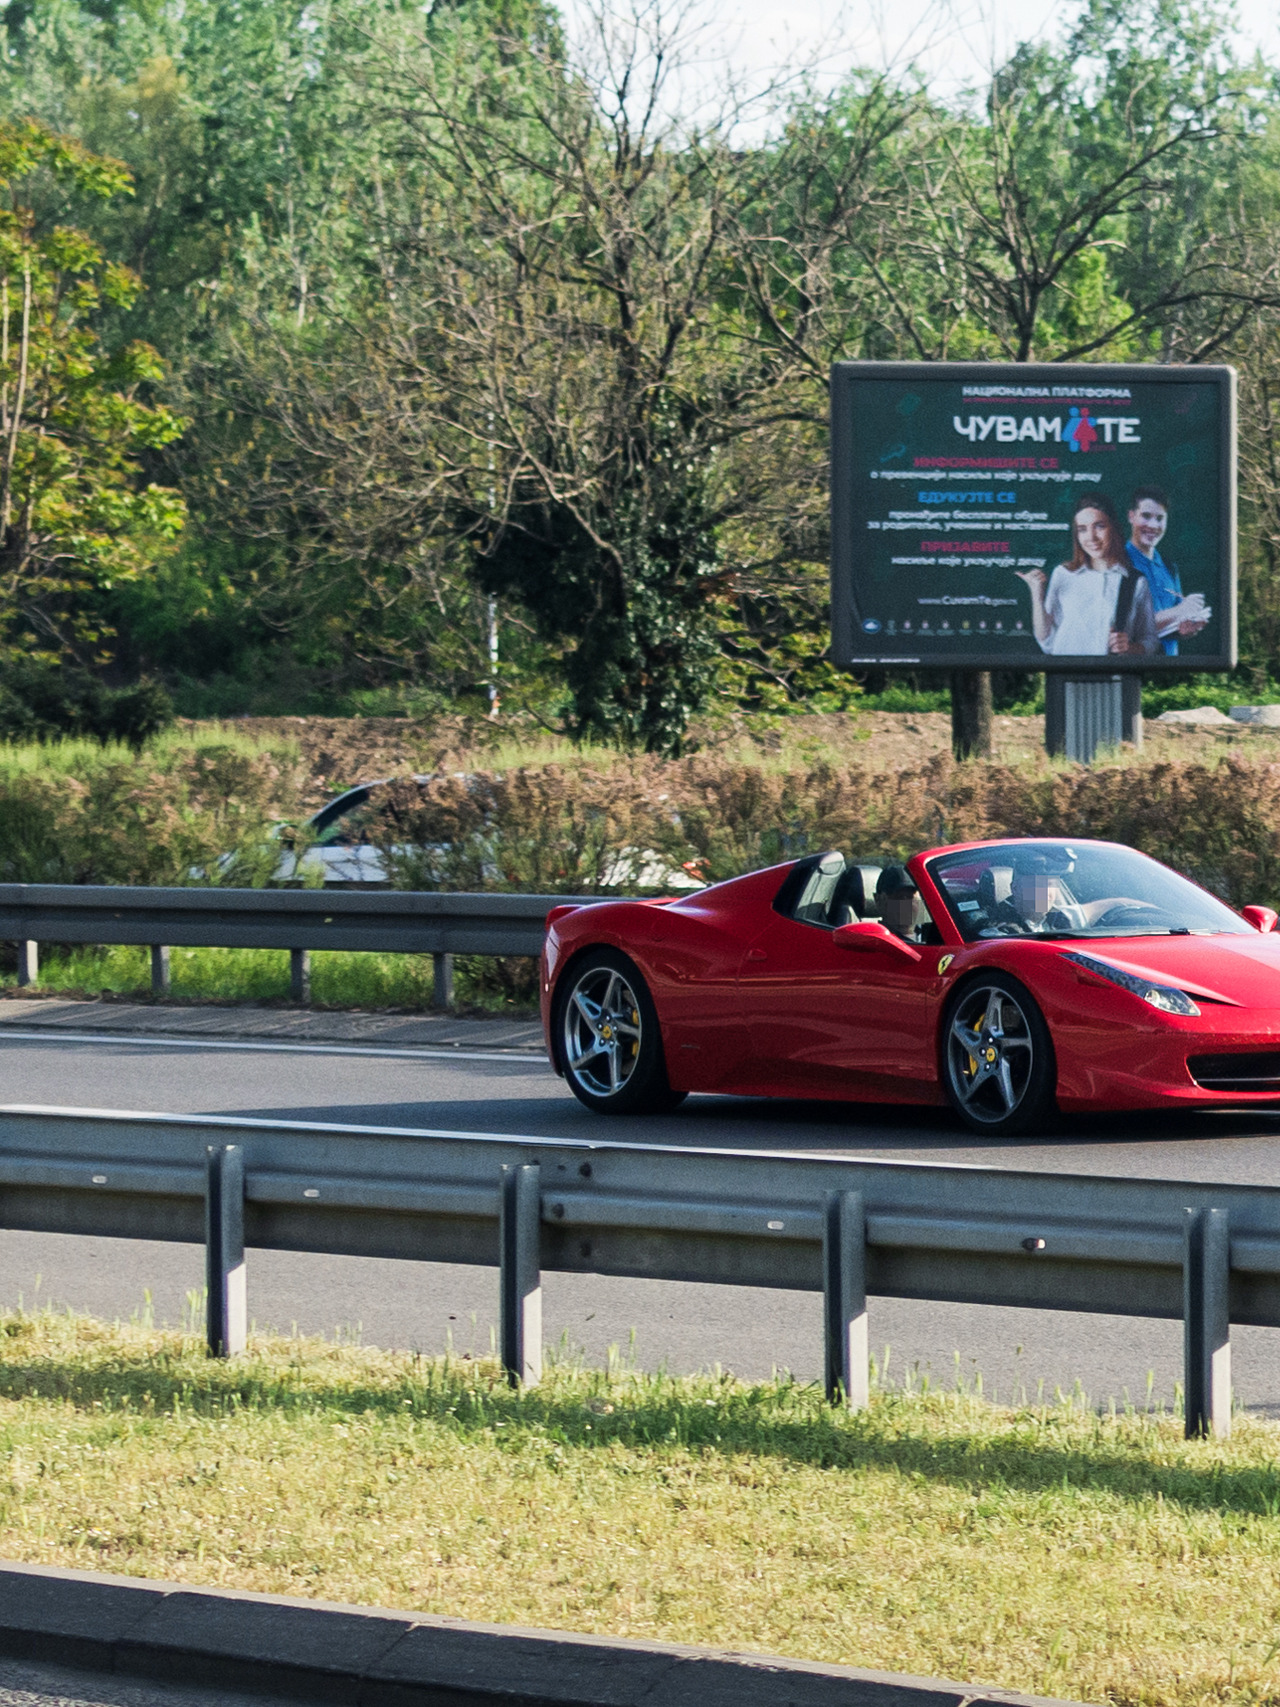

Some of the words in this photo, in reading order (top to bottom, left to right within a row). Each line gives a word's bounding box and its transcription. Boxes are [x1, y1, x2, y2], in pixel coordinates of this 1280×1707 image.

[962, 386, 1050, 397] НАЦИОНАЛНА
[1052, 387, 1131, 398] ПЛАТФОРМА
[953, 416, 1062, 442] ЧУВАМ
[1096, 417, 1141, 443] ТЕ
[1039, 458, 1059, 469] СЕ
[918, 491, 994, 504] ЕДУКУЈТЕ
[996, 491, 1016, 503] СЕ
